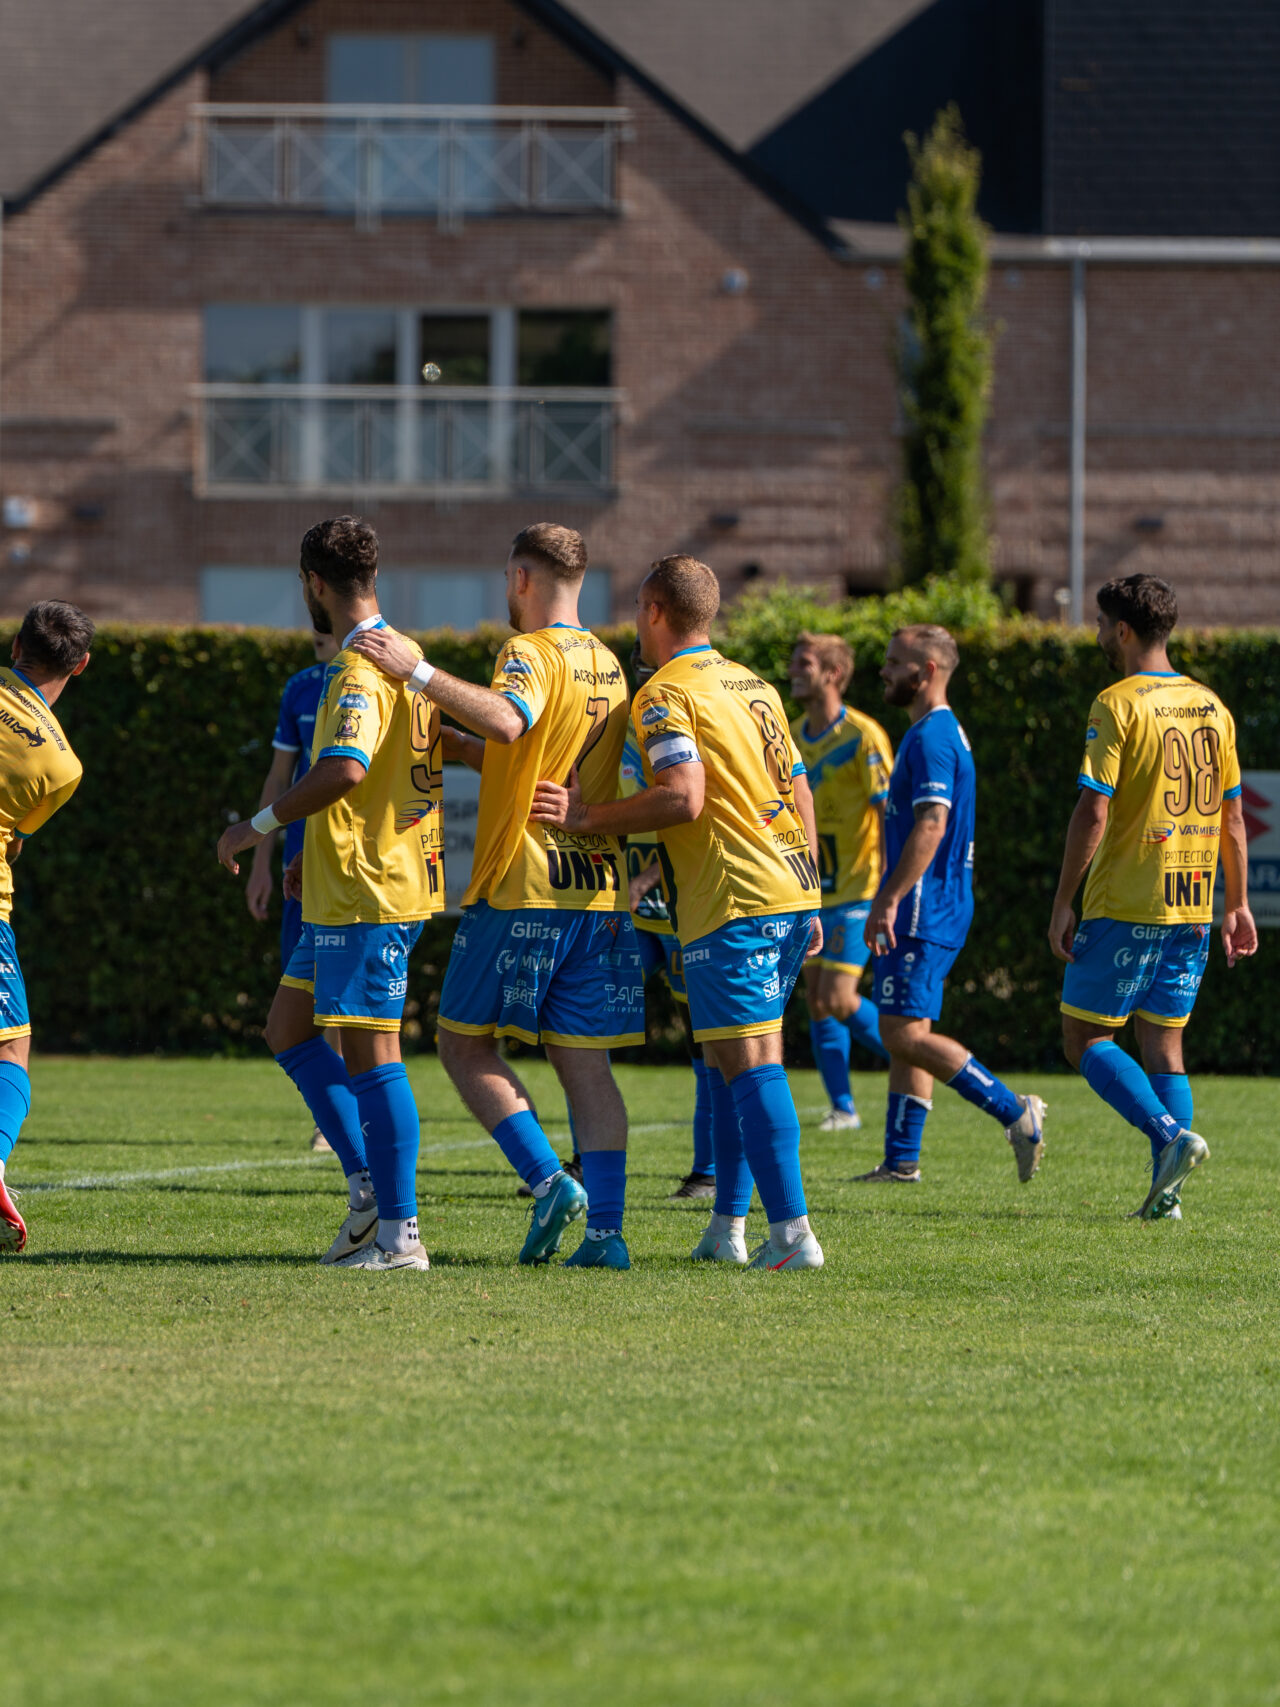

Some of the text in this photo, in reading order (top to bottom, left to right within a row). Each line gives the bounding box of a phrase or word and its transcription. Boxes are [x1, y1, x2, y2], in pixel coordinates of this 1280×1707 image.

[574, 696, 610, 776] 7
[749, 699, 793, 795] 8
[1163, 726, 1222, 817] 98
[881, 975, 895, 997] 6
